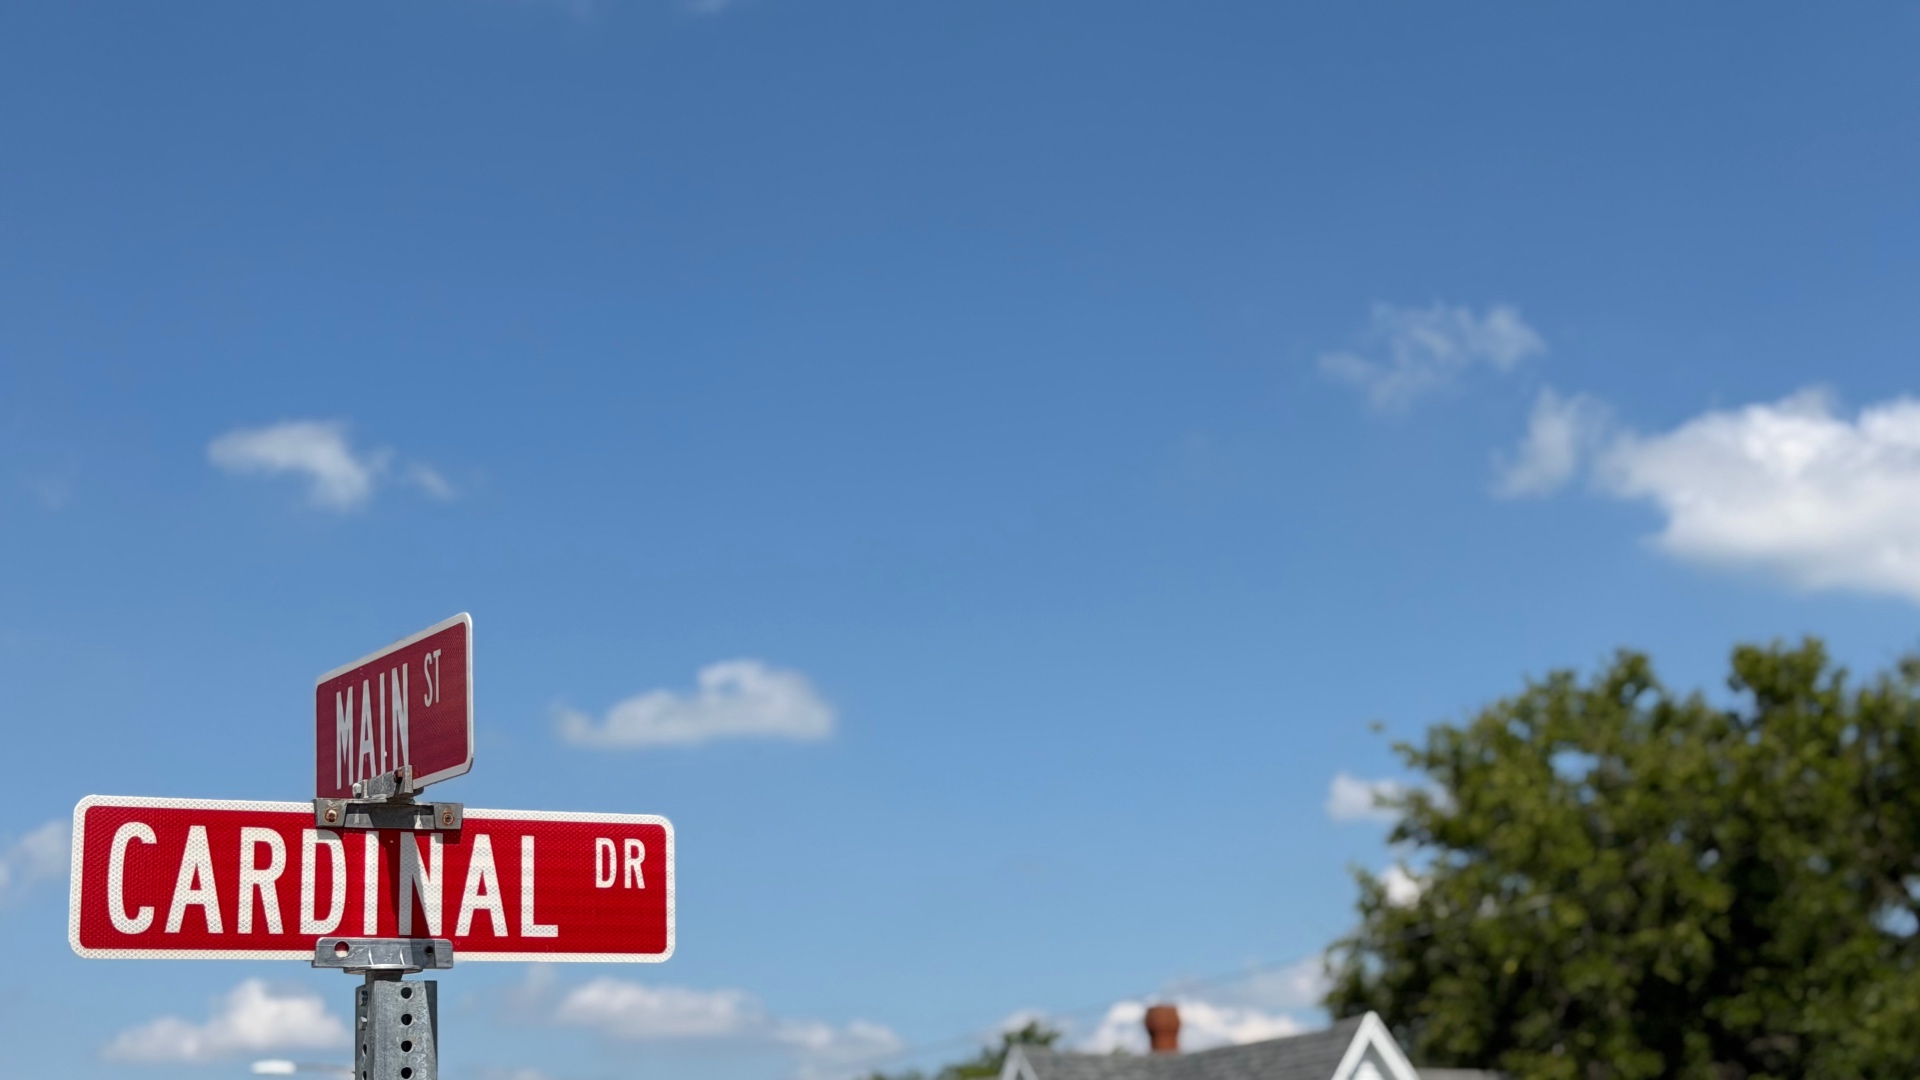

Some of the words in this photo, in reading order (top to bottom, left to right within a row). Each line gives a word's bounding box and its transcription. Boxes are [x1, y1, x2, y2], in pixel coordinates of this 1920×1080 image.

[336, 663, 409, 790] MAIN
[424, 648, 441, 707] ST
[107, 821, 559, 938] CARDINAL
[595, 837, 646, 889] DR
